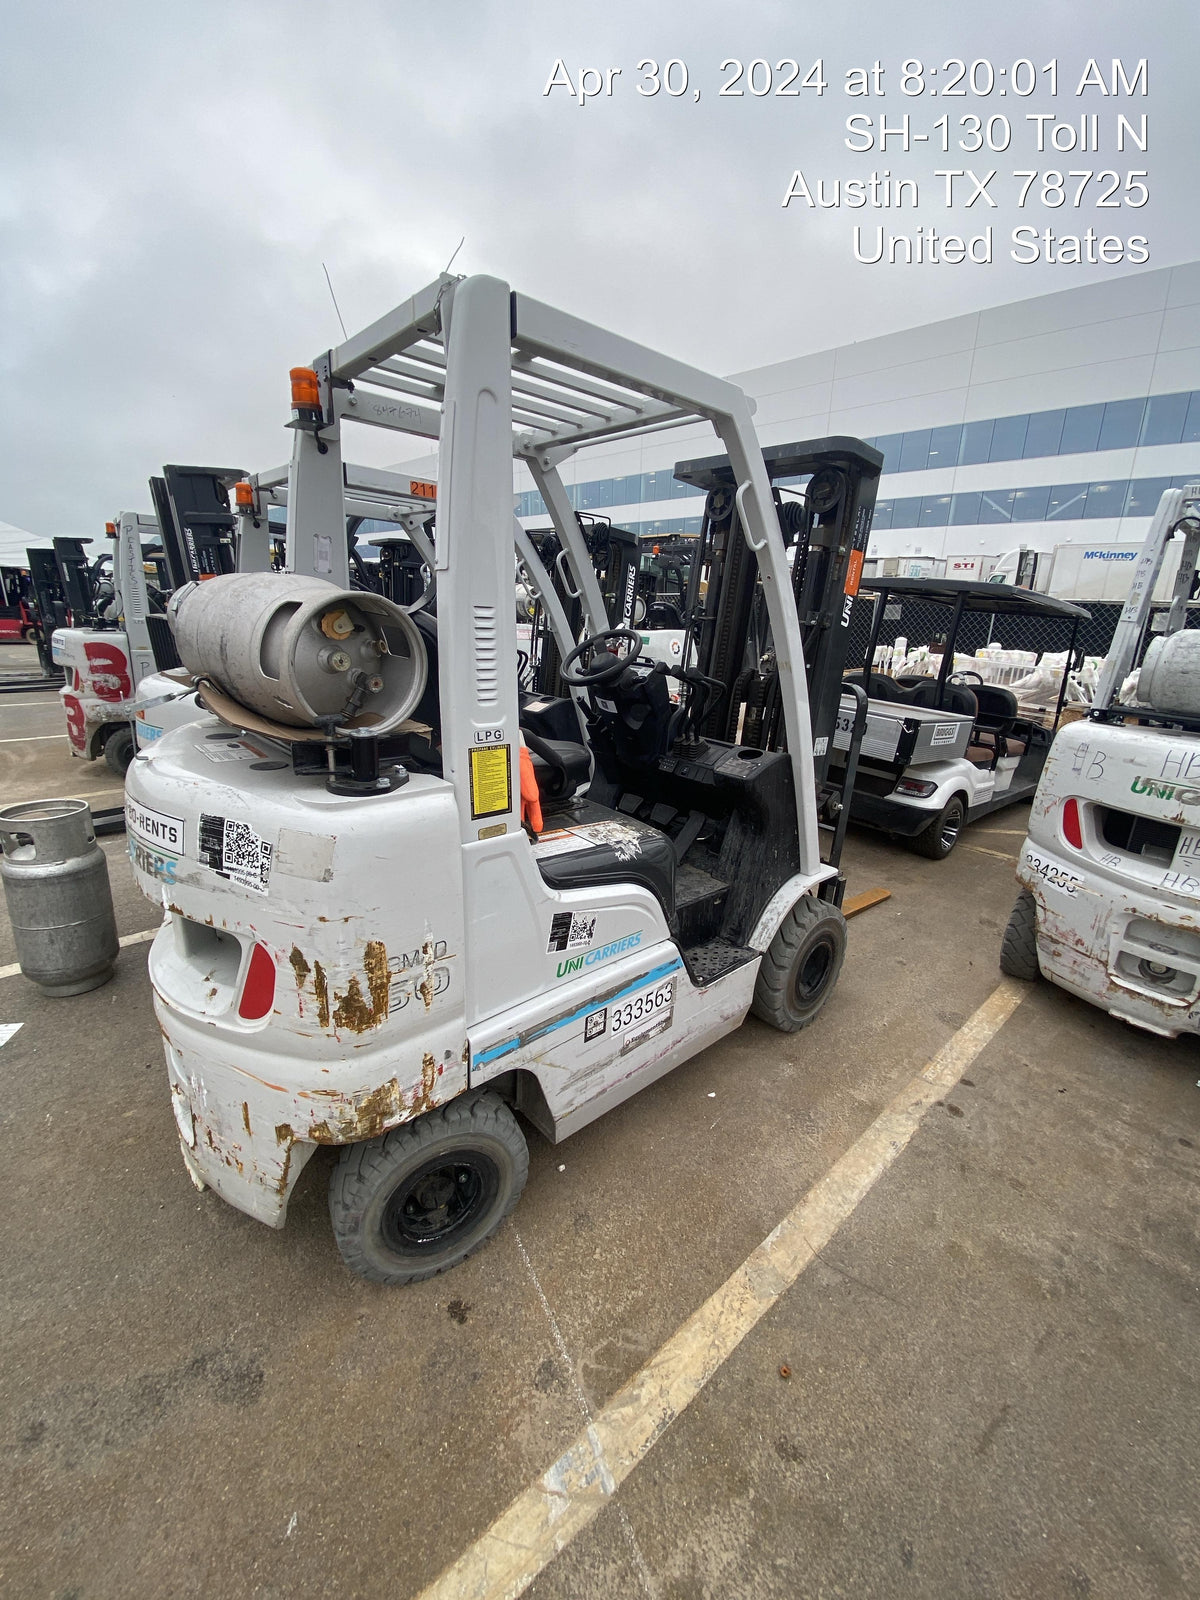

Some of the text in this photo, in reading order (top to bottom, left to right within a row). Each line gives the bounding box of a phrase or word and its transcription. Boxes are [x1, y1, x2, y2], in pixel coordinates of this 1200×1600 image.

[477, 730, 502, 741] LPG
[556, 932, 643, 978] UNICARRIERS
[612, 982, 673, 1032] 333563
